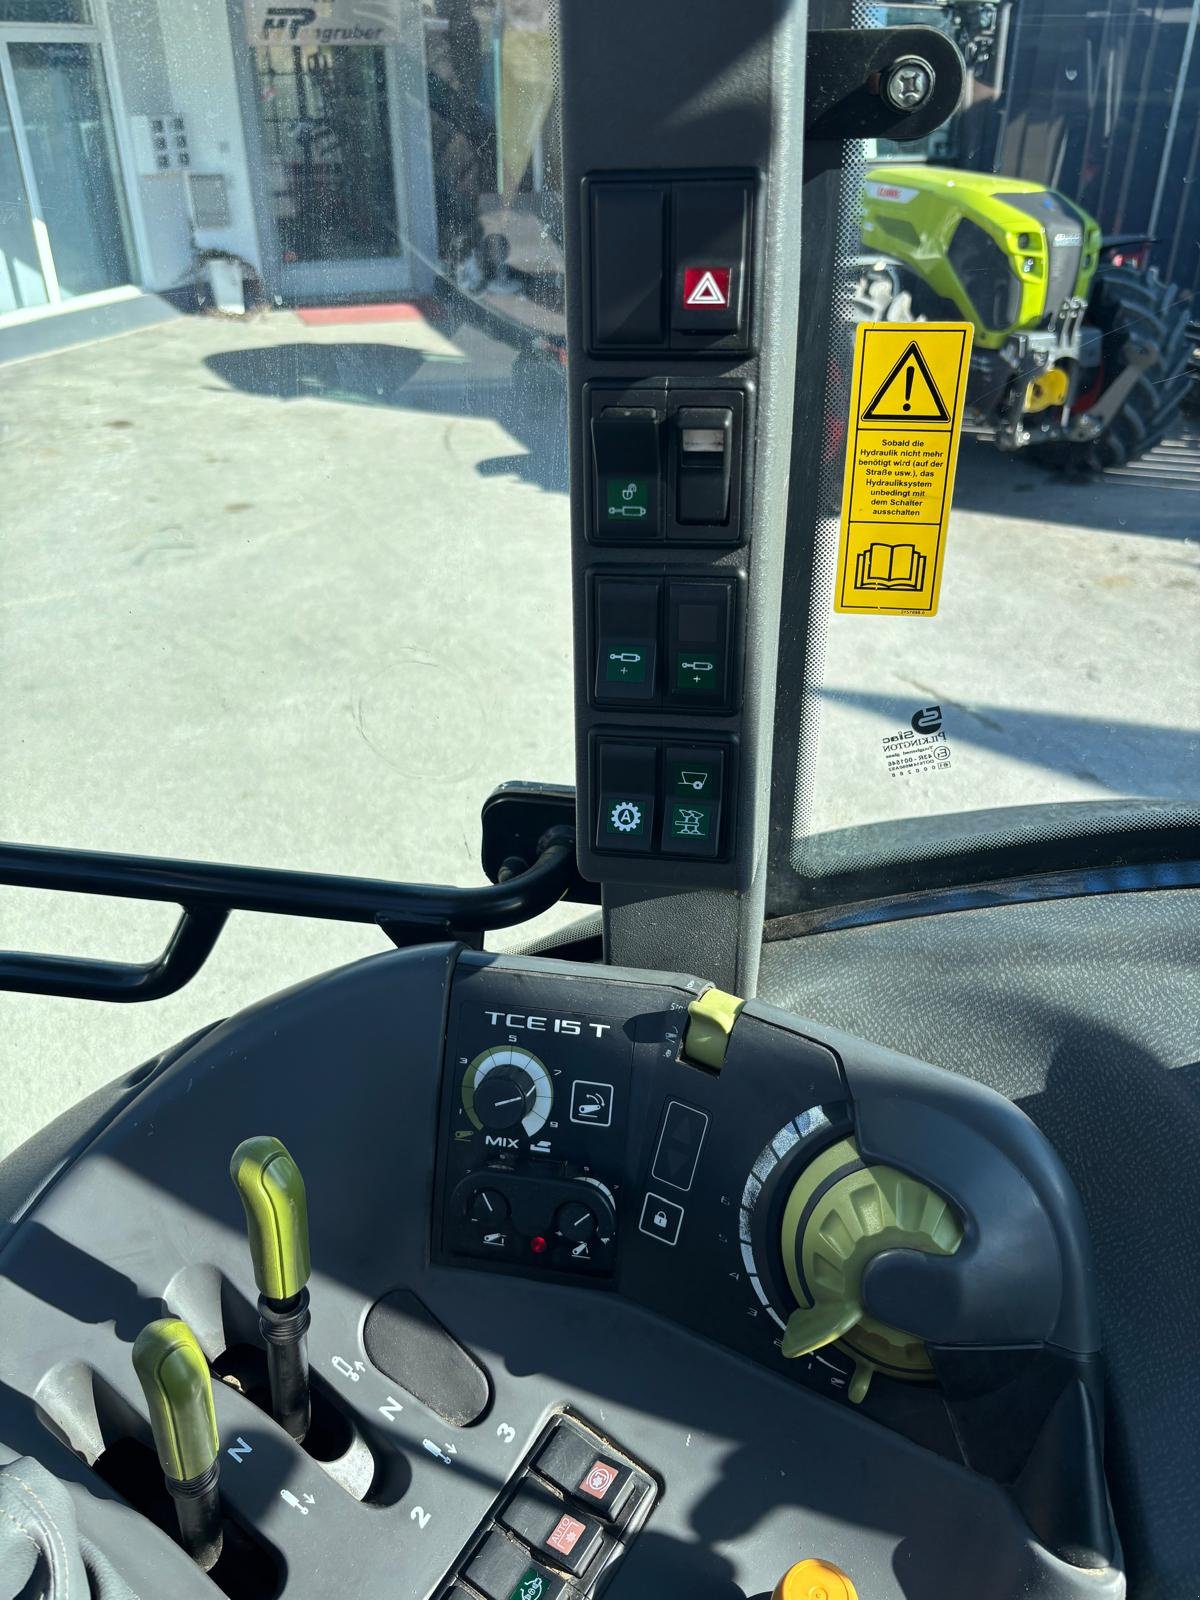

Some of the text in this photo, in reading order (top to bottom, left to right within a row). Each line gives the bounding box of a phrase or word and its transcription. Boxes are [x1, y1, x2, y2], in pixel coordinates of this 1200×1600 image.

[882, 439, 924, 448] Sobald die
[860, 449, 944, 458] Hydraulik nicht mehr
[858, 459, 944, 468] benötigt wird (auf der
[894, 470, 918, 478] usw.),
[865, 479, 932, 488] Hydrauliksystem
[870, 489, 910, 498] unbedingt
[890, 499, 923, 507] Schalter
[872, 508, 920, 516] ausschalten
[485, 1011, 611, 1038] TCE 15 T
[485, 1135, 520, 1149] MIX
[378, 1396, 405, 1422] N
[496, 1422, 516, 1443] 3
[226, 1436, 254, 1464] N
[409, 1505, 433, 1529] 2
[551, 1517, 571, 1542] AUTO
